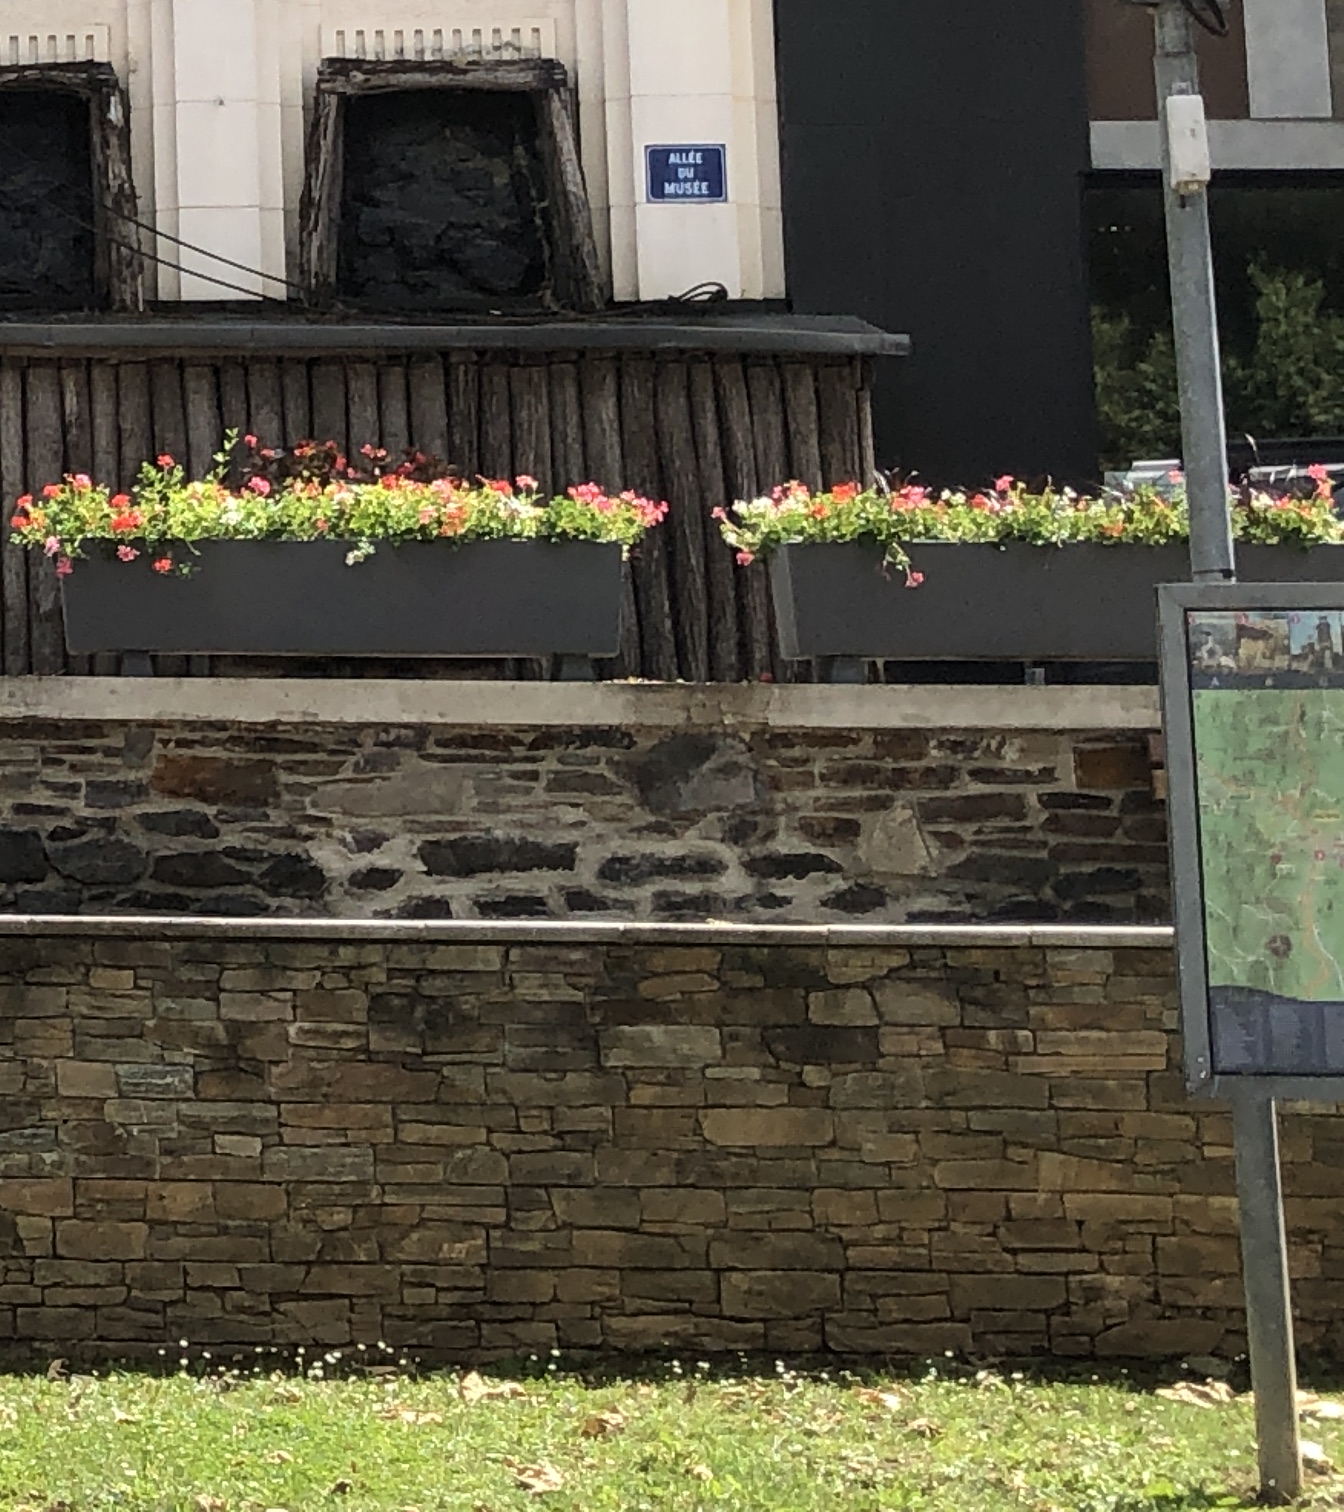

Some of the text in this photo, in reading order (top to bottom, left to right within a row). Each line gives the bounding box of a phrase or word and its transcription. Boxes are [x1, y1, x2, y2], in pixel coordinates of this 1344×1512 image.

[668, 149, 703, 164] ALLÉE
[677, 168, 694, 179] DU
[663, 179, 710, 195] MUSÉE
